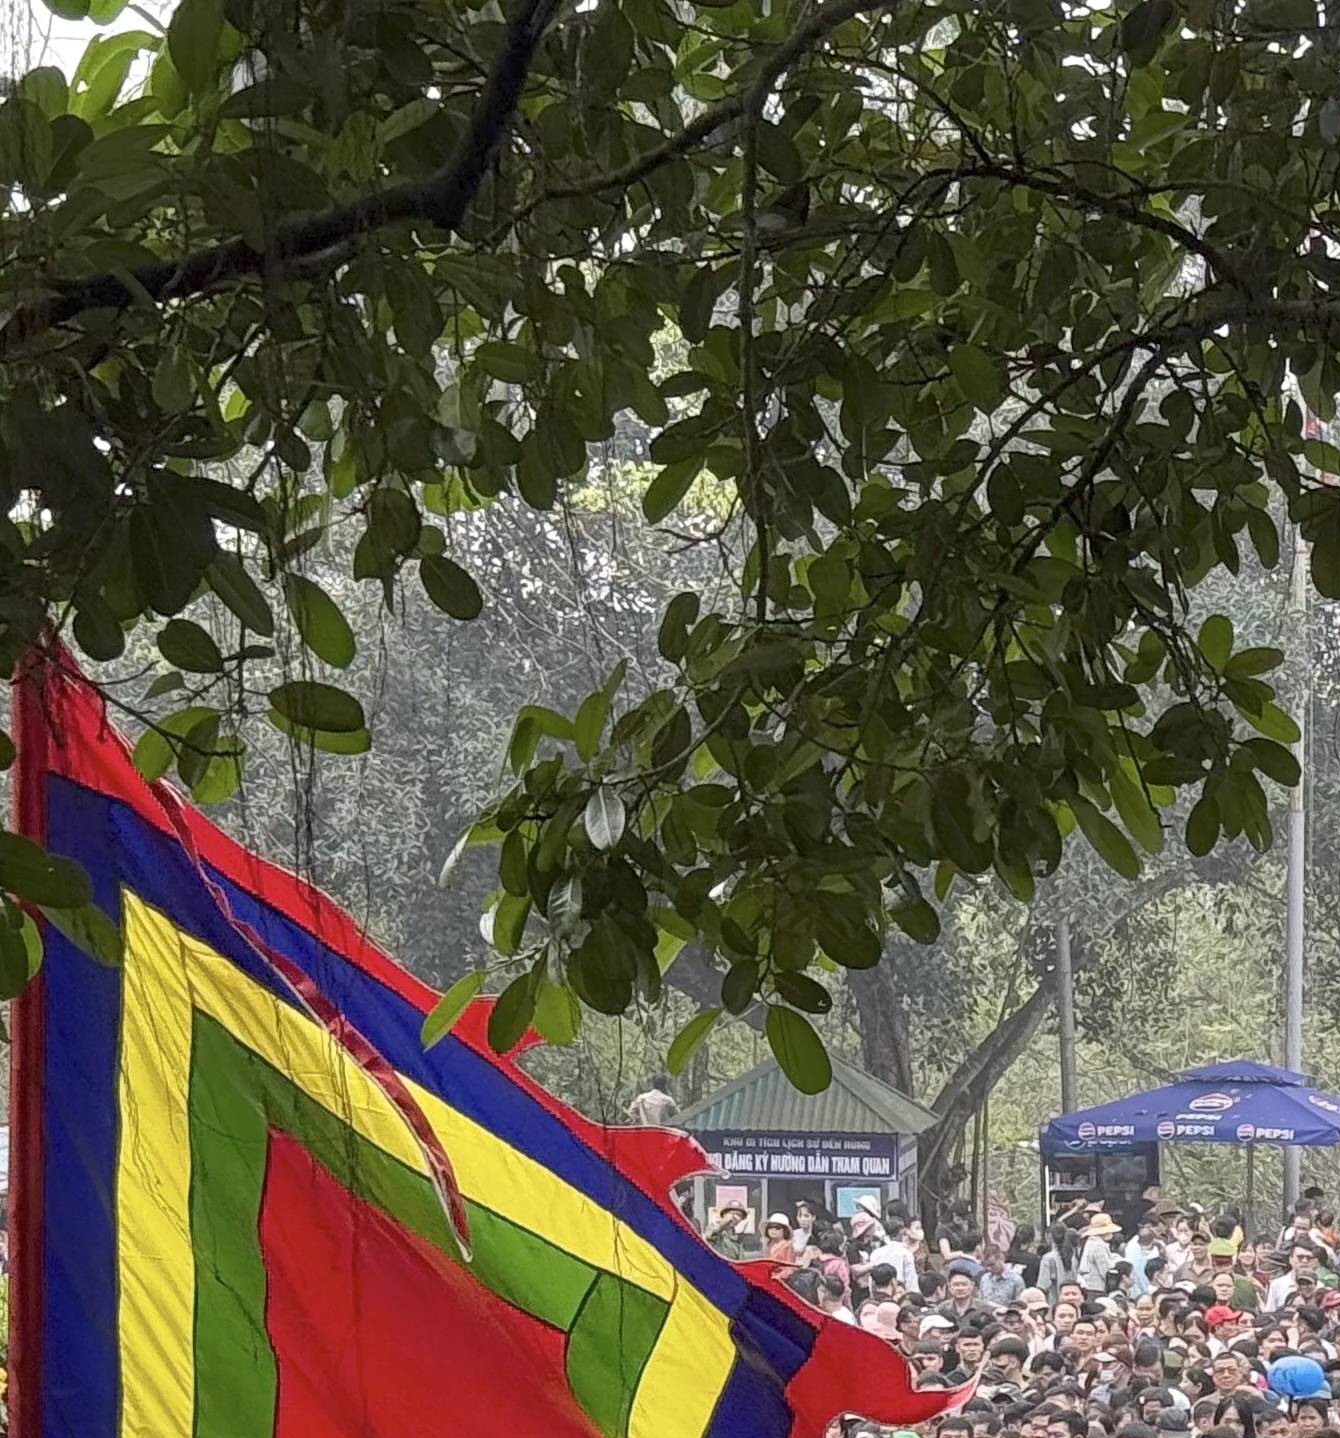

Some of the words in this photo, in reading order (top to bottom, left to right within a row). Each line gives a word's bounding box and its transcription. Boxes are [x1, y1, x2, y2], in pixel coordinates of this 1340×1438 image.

[1097, 1125, 1135, 1137] PEPSI
[1176, 1125, 1215, 1136] PEPSI
[1256, 1128, 1295, 1140] PEPSI
[755, 1151, 769, 1174] KÝ
[831, 1156, 861, 1174] THAM
[862, 1157, 890, 1176] QUAN
